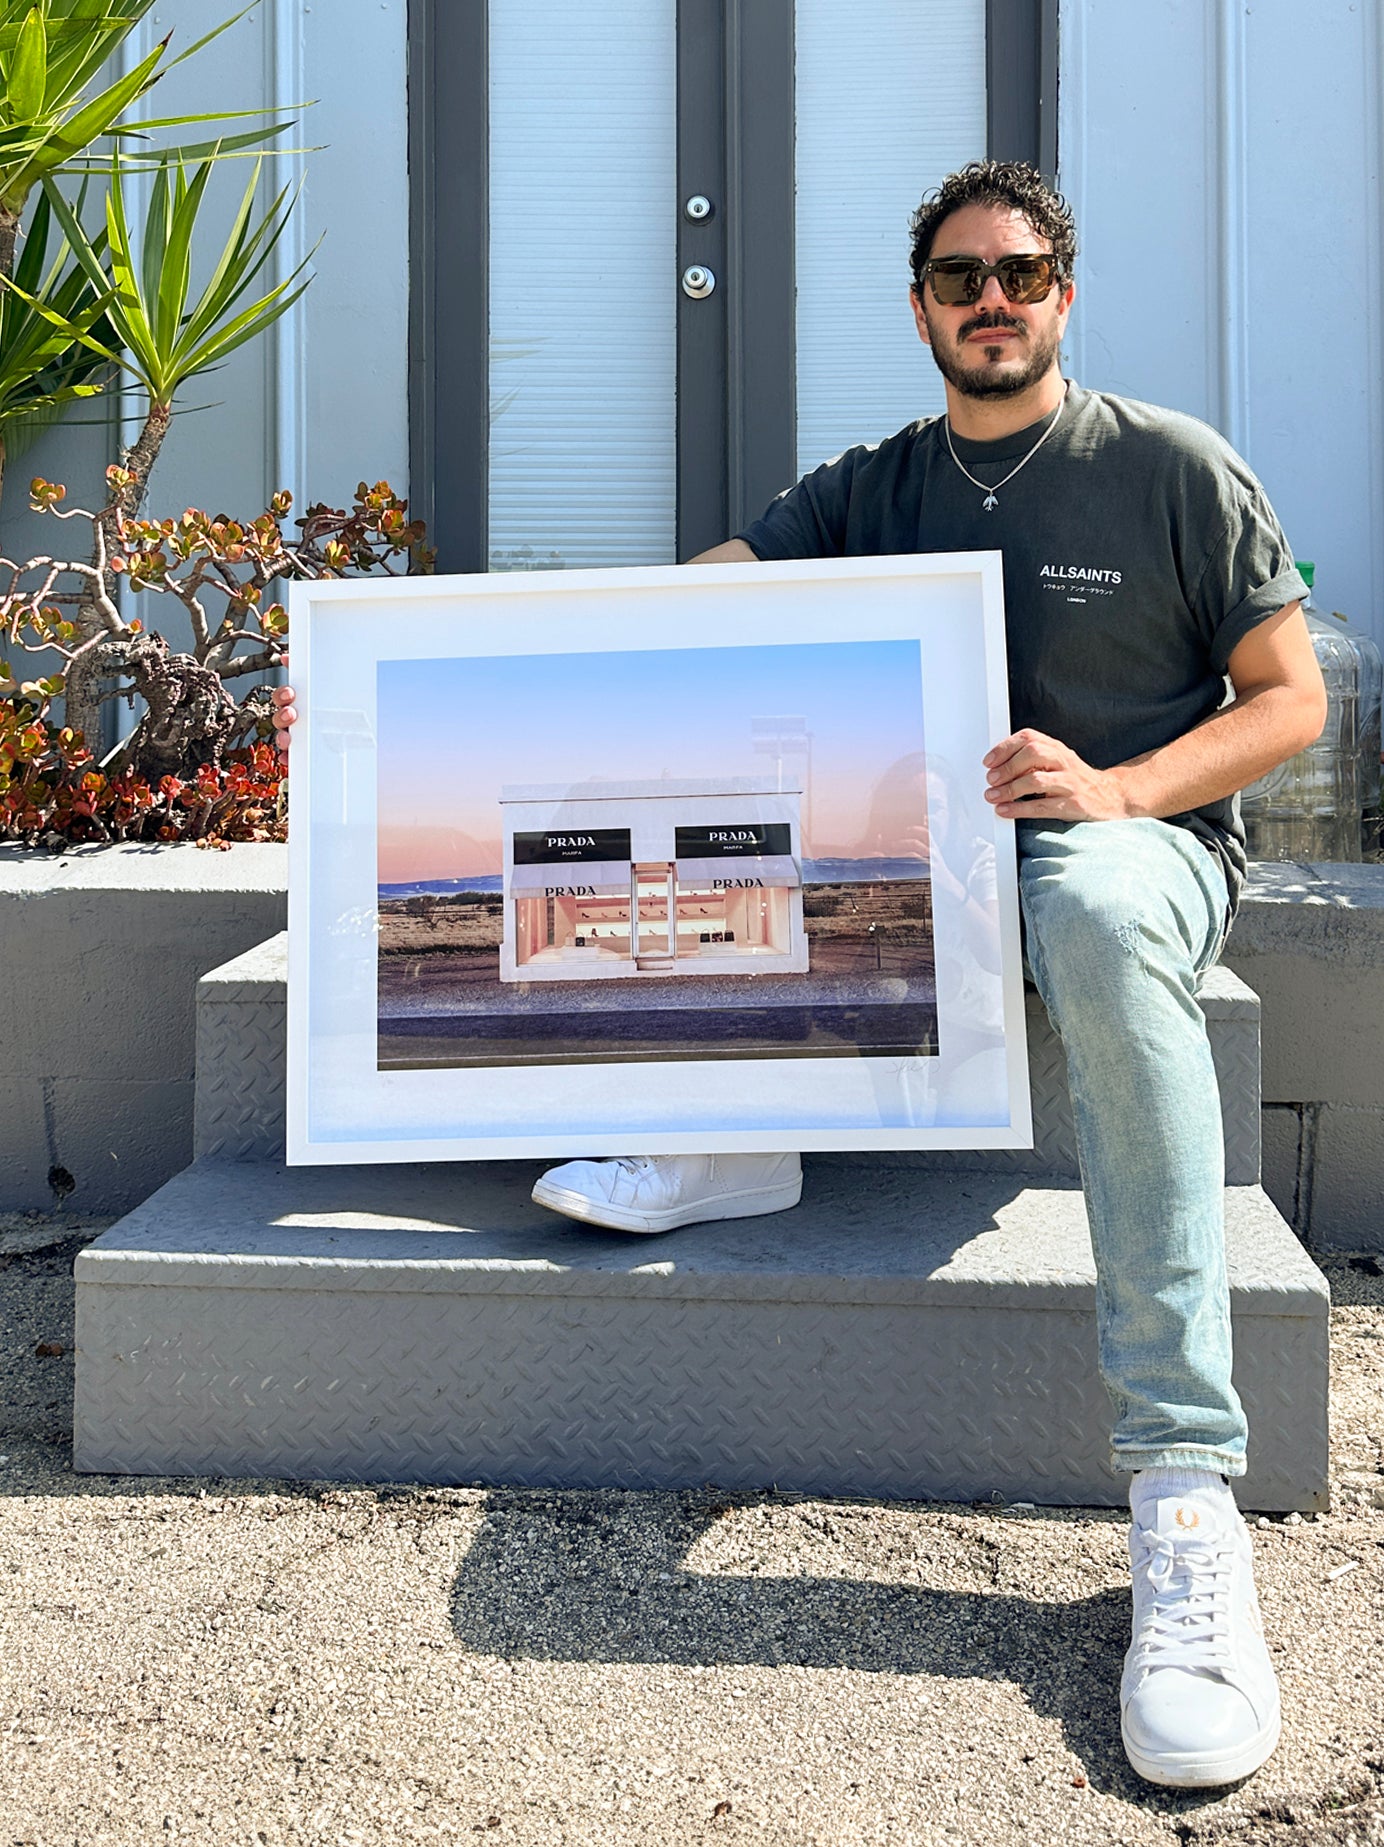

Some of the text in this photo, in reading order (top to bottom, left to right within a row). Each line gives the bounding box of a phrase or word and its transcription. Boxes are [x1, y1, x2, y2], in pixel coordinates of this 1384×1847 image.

[1039, 565, 1122, 584] ALLSAINTS
[547, 836, 596, 848] PRADA
[708, 830, 757, 842] PRADA
[712, 877, 765, 889] PRADA
[544, 885, 597, 897] PRADA
